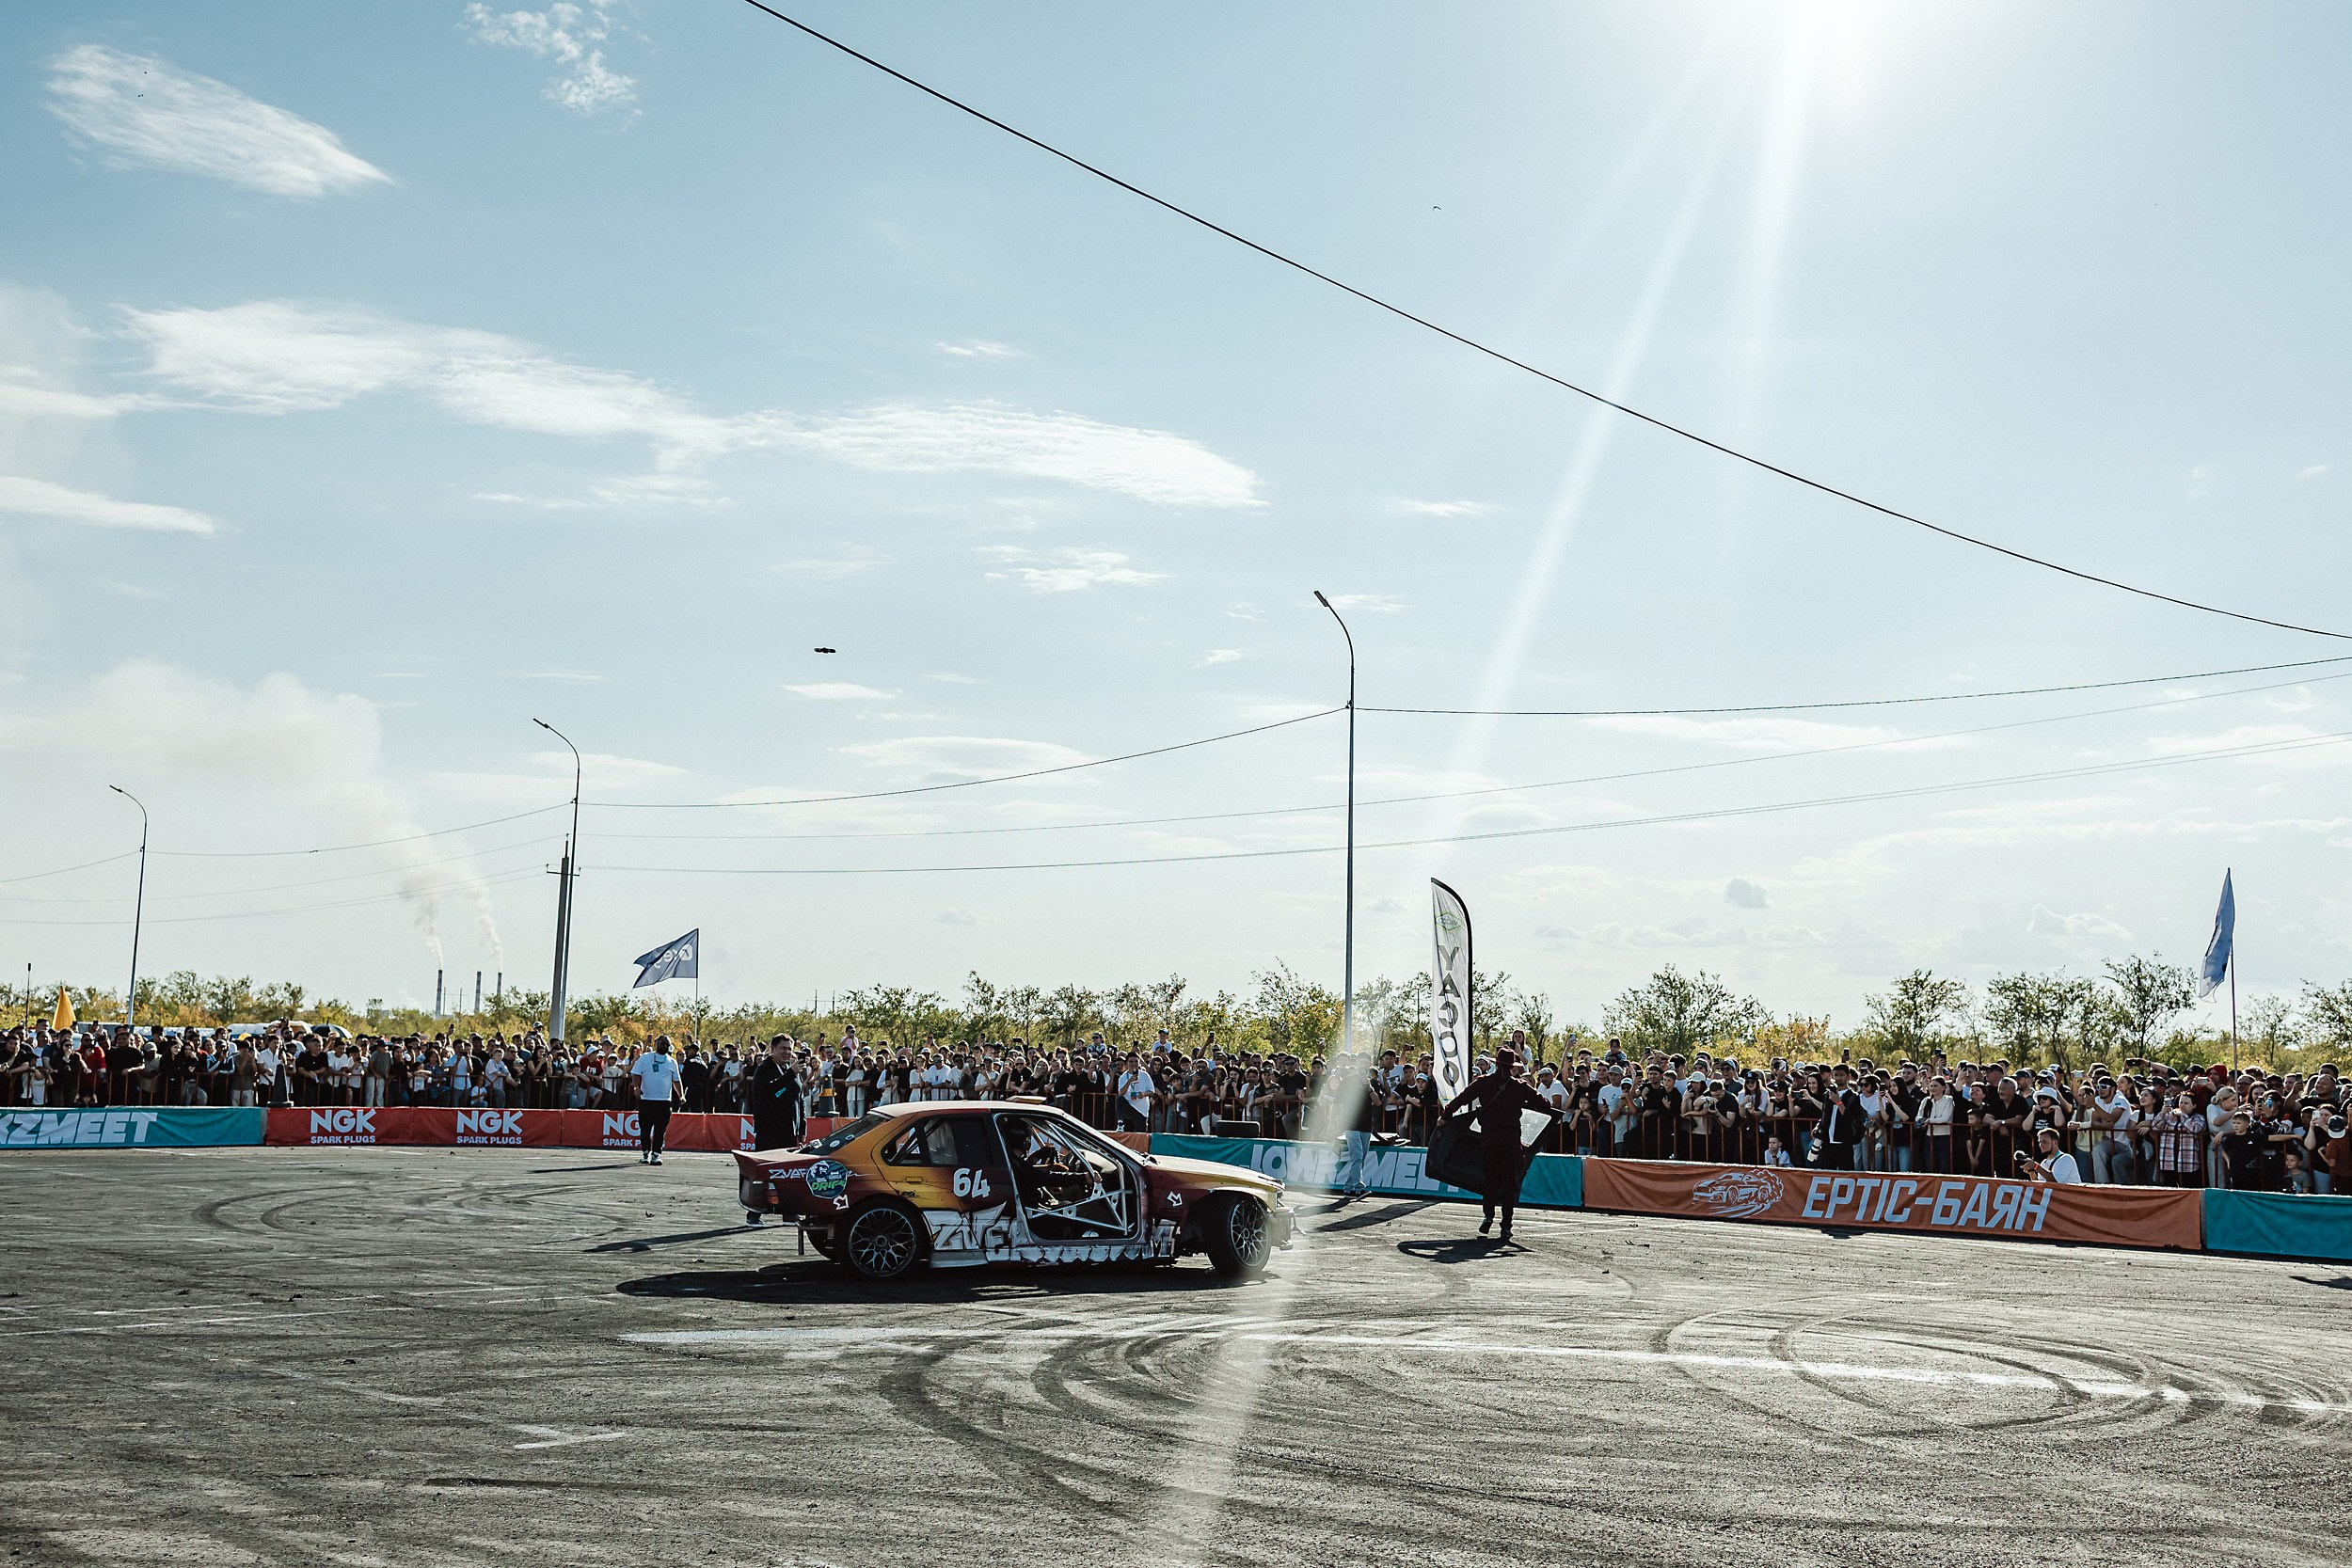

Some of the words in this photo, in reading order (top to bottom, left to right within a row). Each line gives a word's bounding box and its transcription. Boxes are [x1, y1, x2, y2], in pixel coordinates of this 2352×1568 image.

[310, 1109, 376, 1133] NGK
[456, 1111, 523, 1134] NGK
[603, 1113, 641, 1136] NG
[310, 1135, 342, 1144] SPARK
[343, 1135, 375, 1144] PLUGS
[456, 1136, 488, 1145] SPARK
[490, 1136, 522, 1145] PLUGS
[603, 1138, 633, 1147] SPARK
[740, 1142, 756, 1150] SPA
[953, 1167, 991, 1197] 64
[1802, 1176, 2053, 1231] ЕРТІС-БАЯН
